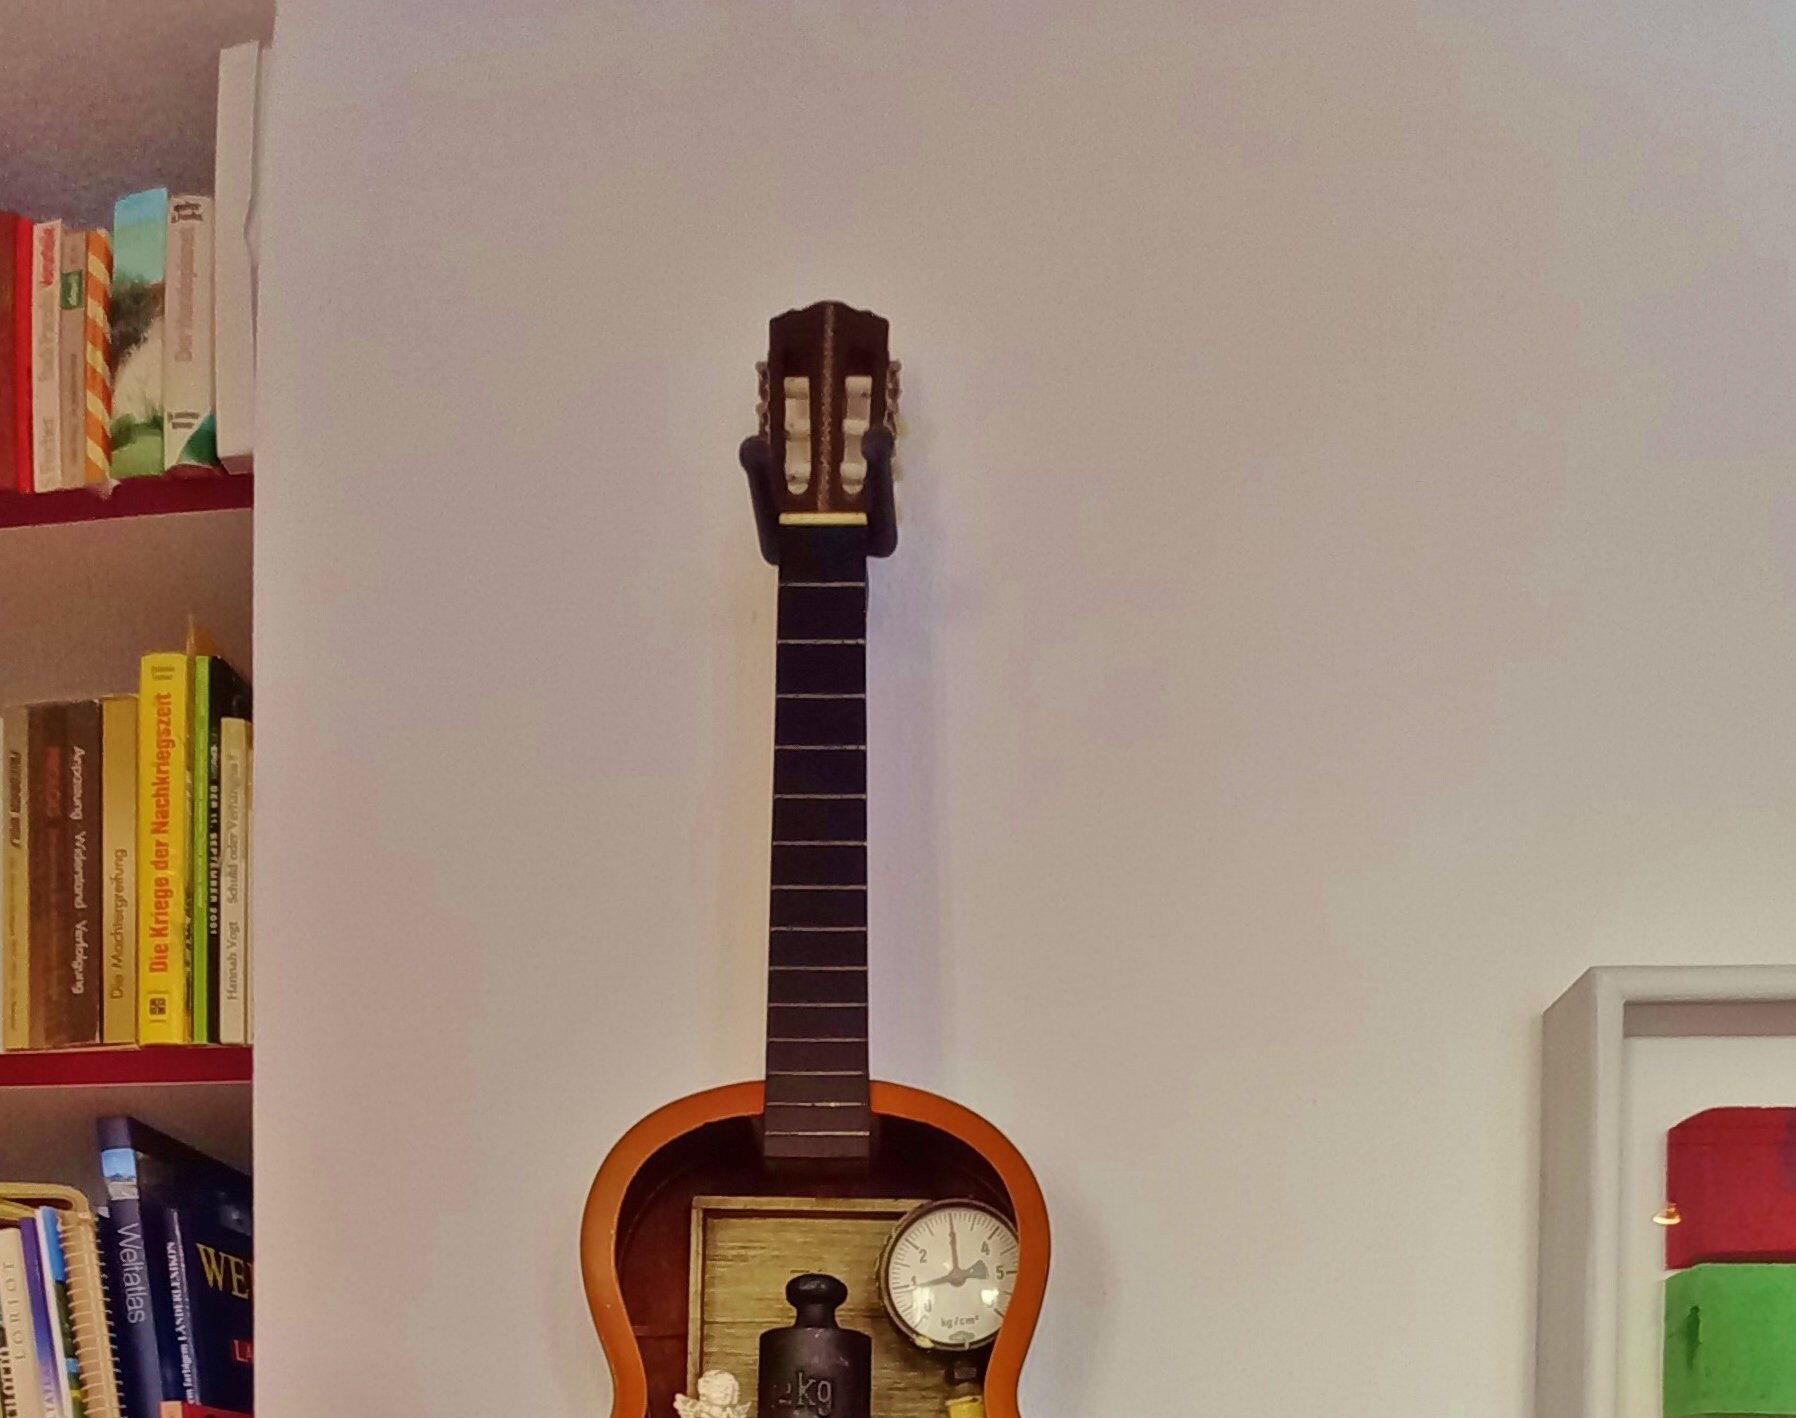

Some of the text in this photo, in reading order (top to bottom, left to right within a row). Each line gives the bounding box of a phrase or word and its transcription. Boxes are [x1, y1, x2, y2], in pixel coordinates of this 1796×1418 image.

[151, 692, 177, 836] Nachkriegszeit
[150, 839, 169, 872] der
[149, 874, 174, 937] Kriege
[148, 938, 168, 973] Die
[196, 1242, 254, 1300] WE
[919, 1249, 927, 1264] 2
[980, 1241, 990, 1256] 4
[116, 1222, 148, 1325] Weltatlas
[995, 1265, 1004, 1280] 5
[3, 1262, 26, 1361] LORIOT
[797, 1371, 831, 1417] kg
